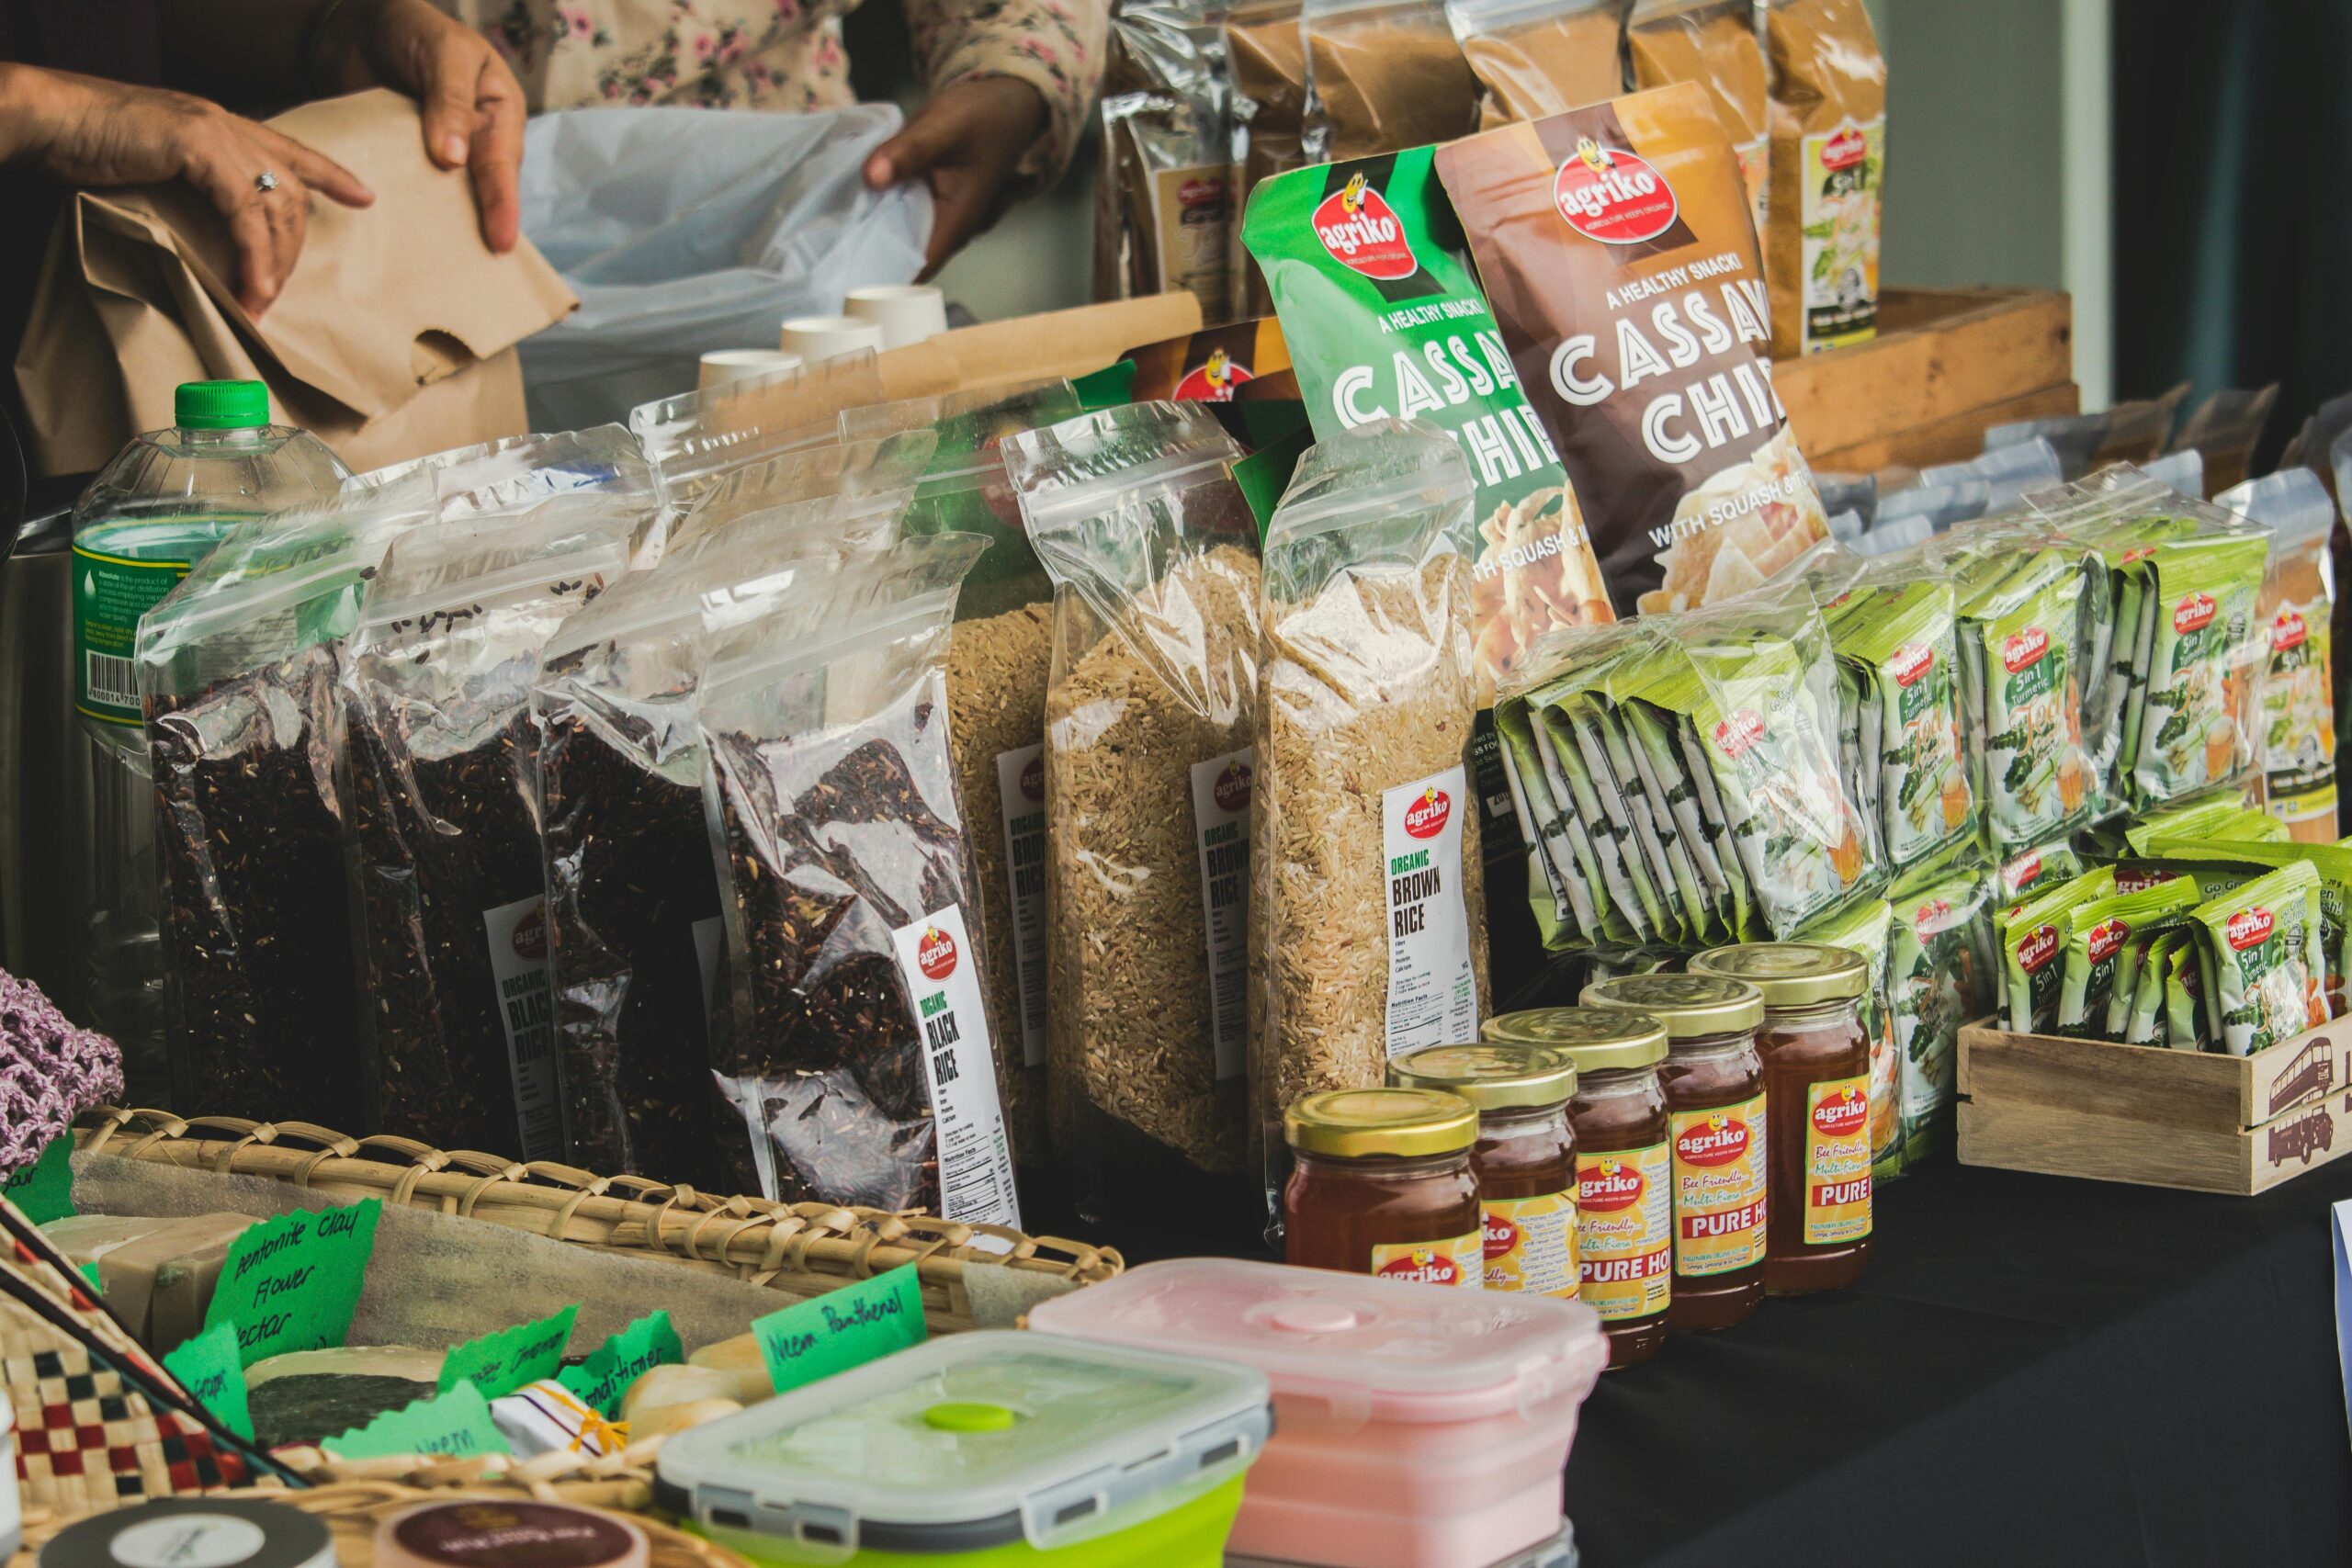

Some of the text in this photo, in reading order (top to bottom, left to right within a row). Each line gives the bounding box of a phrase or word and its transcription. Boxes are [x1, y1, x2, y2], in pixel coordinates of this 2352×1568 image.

[1560, 171, 1657, 218] agriko
[1319, 213, 1396, 255] agriko
[1606, 252, 1744, 310] A HEALTHY SNACK!
[1378, 298, 1486, 334] A HEALTHY SNACK!
[1647, 475, 1793, 548] WITH SQUASH &
[1498, 533, 1565, 571] SQUASH
[2176, 603, 2214, 624] agriko
[2005, 634, 2045, 663] agriko
[93, 691, 120, 704] 800014
[2011, 678, 2050, 706] Turmeric
[1021, 772, 1045, 789] agr
[1215, 773, 1251, 797] agriko
[1407, 801, 1447, 827] agriko
[1204, 820, 1238, 848] ORGANIC
[1012, 832, 1046, 867] BRO
[1390, 848, 1430, 875] ORGANIC
[1210, 874, 1239, 909] RICE
[1392, 865, 1441, 907] BROWN
[2205, 883, 2222, 894] Go
[1394, 902, 1425, 939] RICE
[2229, 915, 2271, 941] agriko
[920, 941, 954, 966] agriko
[1396, 955, 1411, 964] Protein
[2018, 932, 2054, 964] agriko
[1395, 964, 1412, 974] Calcium
[502, 968, 546, 999] ORGANIC
[920, 990, 947, 1019] ORGANIC
[1391, 993, 1428, 1008] Nutrition Facts
[514, 1024, 550, 1066] RICE
[926, 1010, 960, 1052] BLACK
[933, 1048, 959, 1086] RICE
[1815, 1100, 1867, 1124] agriko
[944, 1151, 966, 1163] Nutrition
[965, 1147, 977, 1156] Facts
[1678, 1129, 1746, 1155] agriko
[1683, 1152, 1714, 1160] AGRICULTURE
[1727, 1146, 1744, 1155] ORGANIC
[1815, 1145, 1830, 1159] Bee
[1579, 1176, 1639, 1198] griko
[1682, 1177, 1699, 1190] Bee
[1820, 1179, 1868, 1206] PURE
[317, 1210, 359, 1239] Clay
[1578, 1224, 1588, 1233] ee
[1692, 1208, 1751, 1237] PURE
[1580, 1258, 1643, 1282] PURE
[253, 1264, 316, 1310] Flower
[236, 1312, 292, 1350] ectar
[768, 1287, 904, 1366] Neem Panthenol
